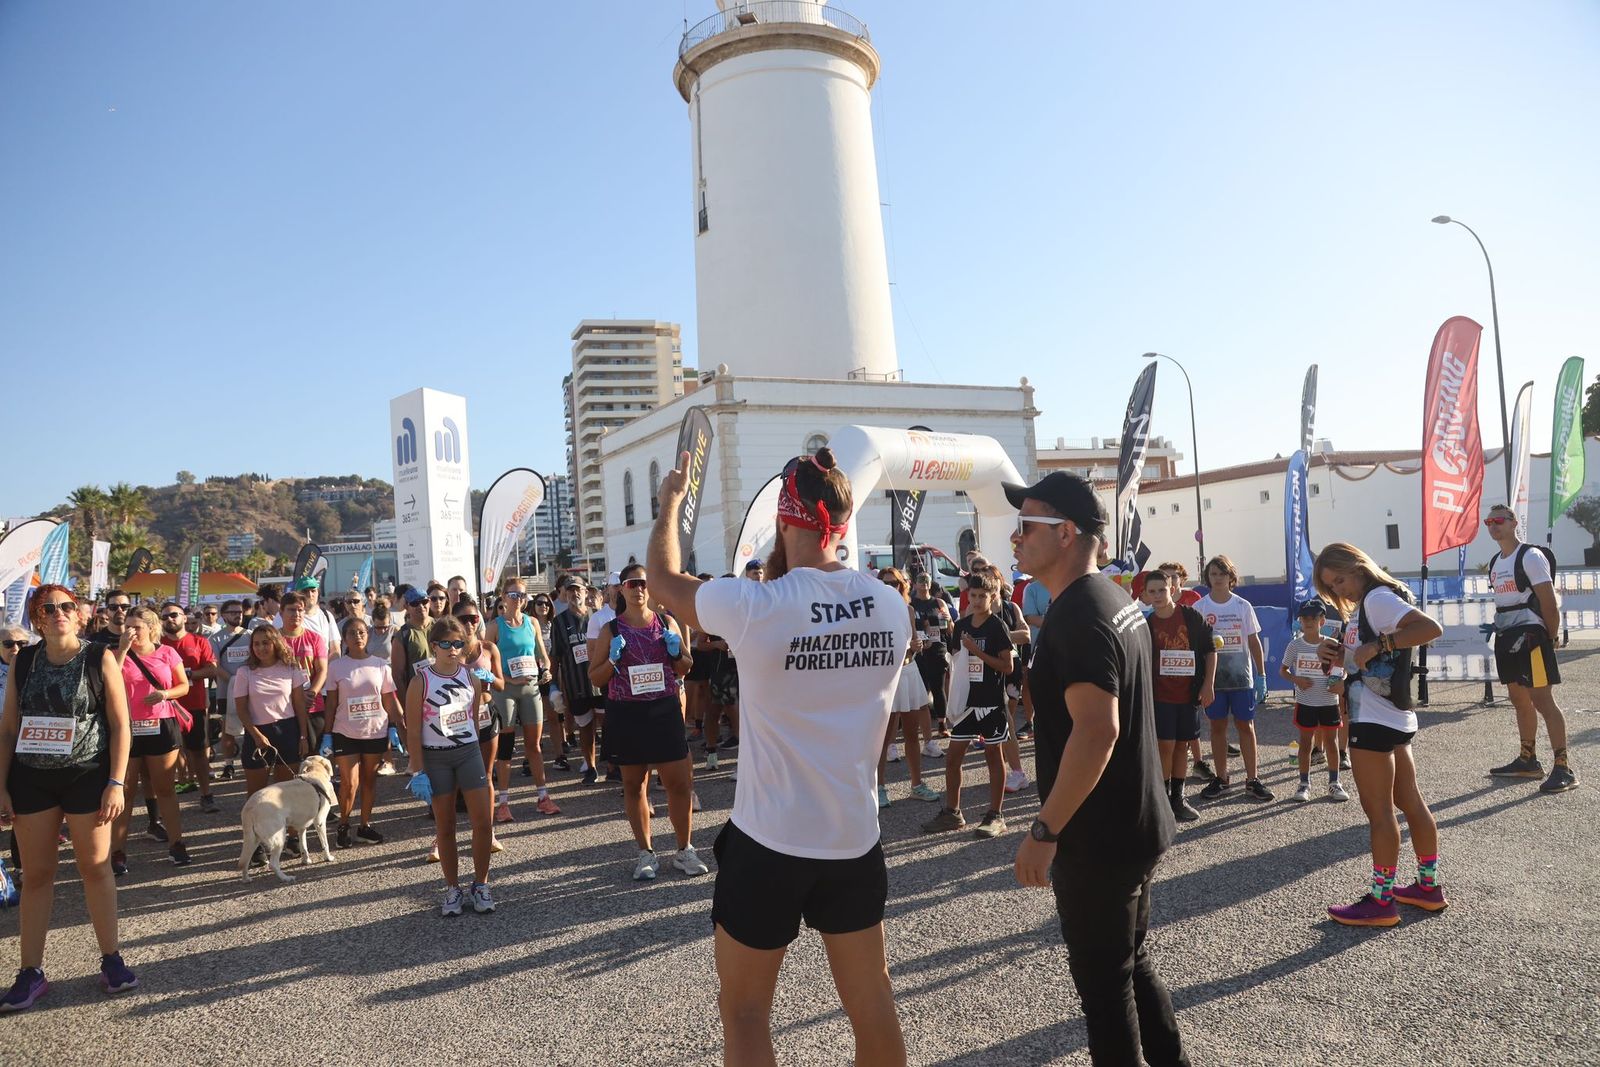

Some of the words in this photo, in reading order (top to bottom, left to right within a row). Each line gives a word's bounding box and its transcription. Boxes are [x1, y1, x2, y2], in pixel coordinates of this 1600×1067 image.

[1433, 351, 1468, 513] PLOGGING
[908, 456, 974, 480] PLOGGING
[682, 428, 707, 535] #BEACTIVE
[506, 484, 541, 533] PLOGGING
[811, 596, 875, 623] STAFF
[789, 631, 895, 653] #HAZDEPORTE
[784, 650, 894, 671] PORELPLANETA
[633, 672, 661, 684] 25069
[351, 703, 378, 712] 24386
[26, 729, 66, 740] 25136
